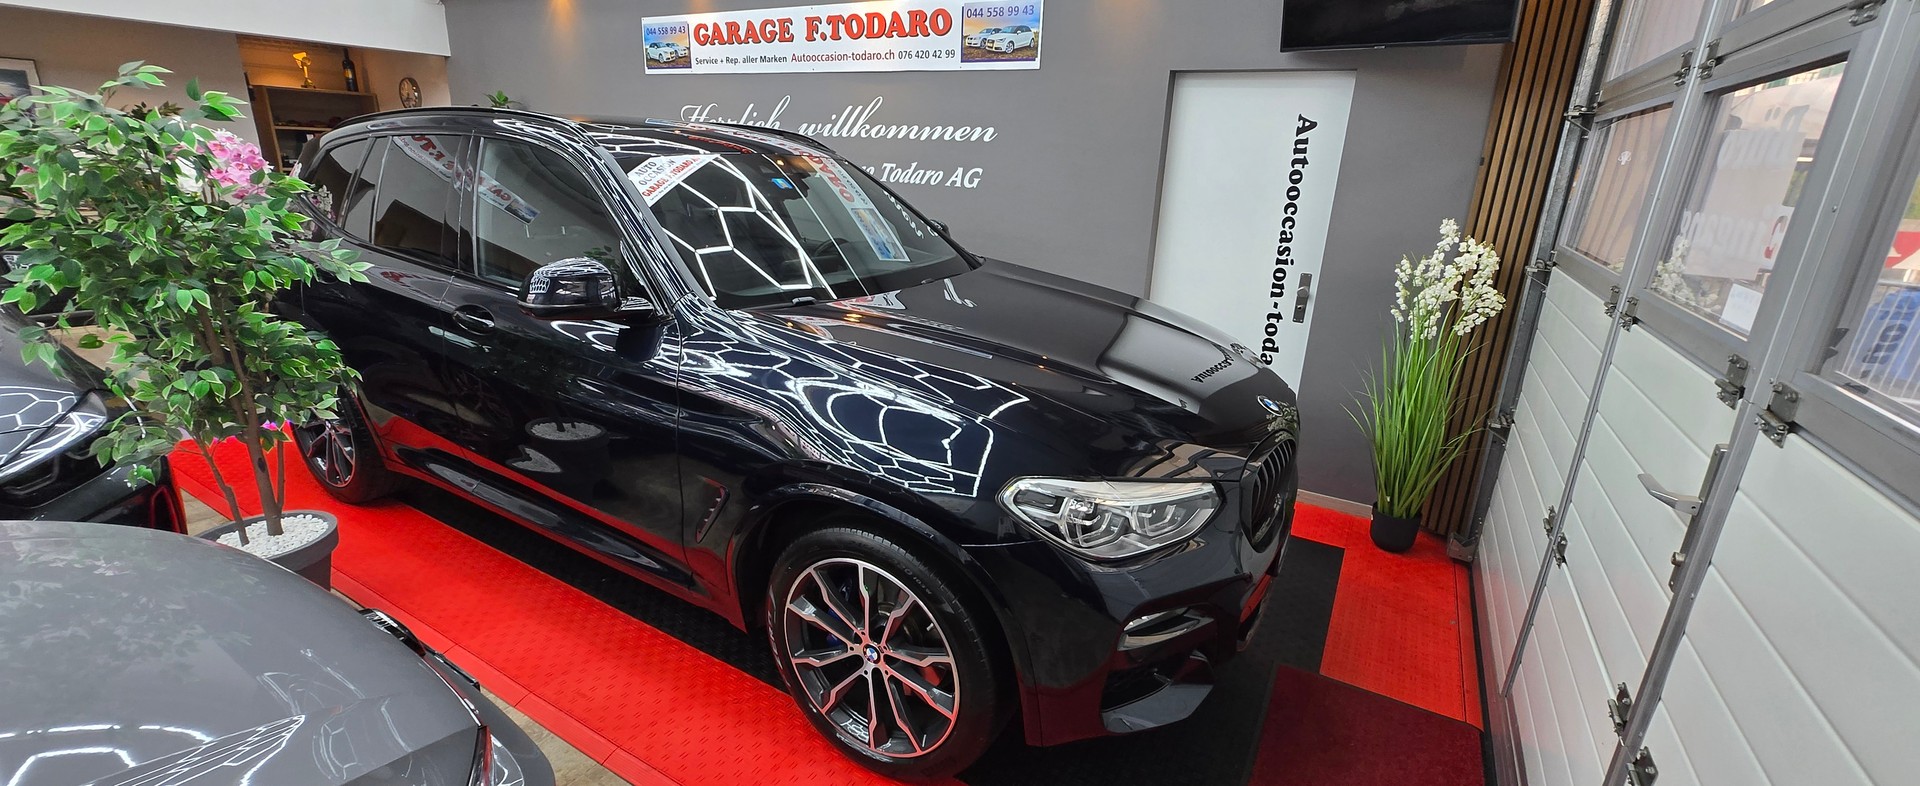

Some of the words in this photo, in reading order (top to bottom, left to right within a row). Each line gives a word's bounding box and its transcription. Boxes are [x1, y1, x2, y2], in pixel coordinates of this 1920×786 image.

[966, 7, 984, 18] 044
[986, 6, 1005, 18] 558
[1007, 5, 1020, 16] 99
[1022, 4, 1035, 16] 43
[645, 26, 657, 36] 044
[658, 26, 669, 35] 558
[669, 25, 678, 35] 99
[678, 25, 686, 34] 43
[693, 17, 795, 47] GARAGE
[804, 8, 953, 42] F.TODARO
[695, 56, 718, 65] Service
[725, 56, 741, 66] Rep.
[742, 55, 758, 64] aller
[759, 54, 787, 63] Marken
[791, 49, 895, 63] Autooccasion-todaro.ch
[898, 50, 913, 60] 076
[914, 49, 930, 60] 420
[931, 49, 943, 59] 42
[944, 49, 956, 59] 99
[798, 96, 999, 143] willkommen
[634, 161, 657, 177] AUTO
[880, 161, 944, 186] Todaro
[944, 166, 984, 189] AG
